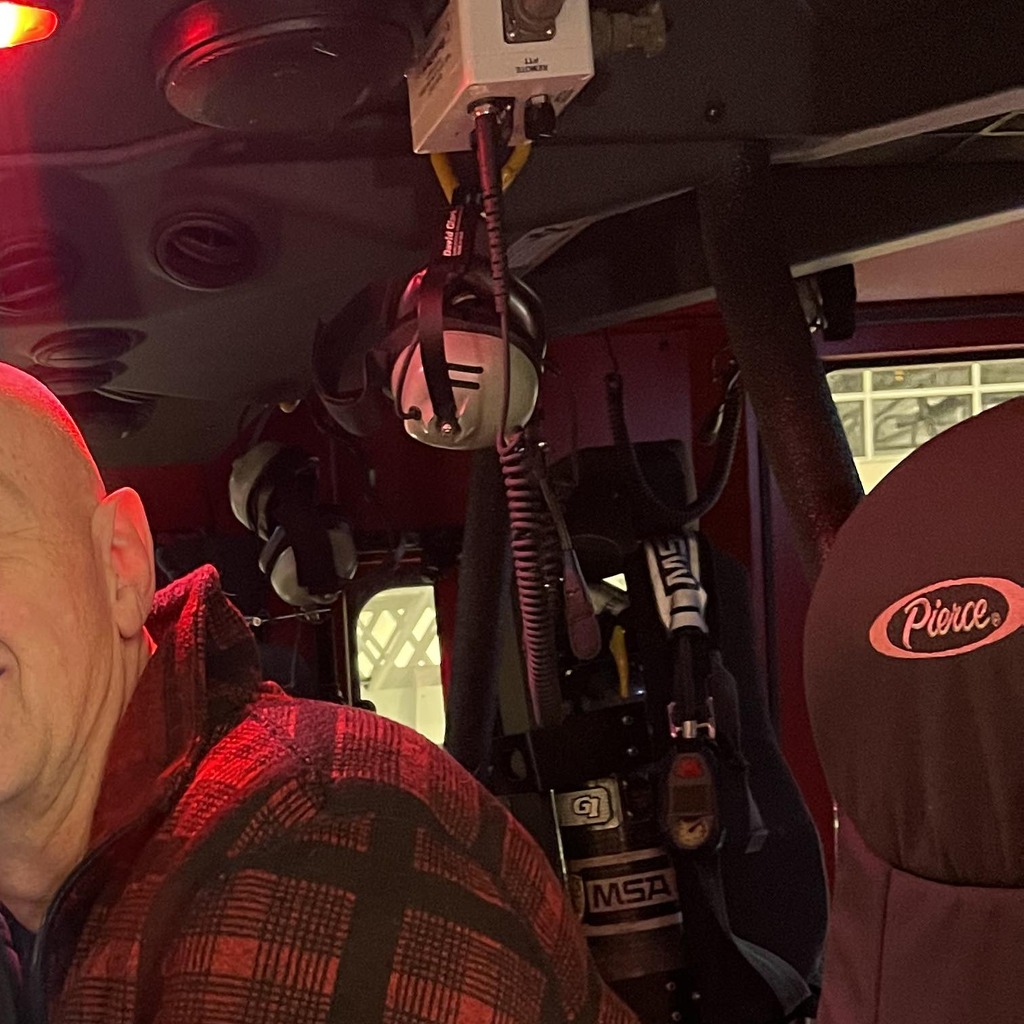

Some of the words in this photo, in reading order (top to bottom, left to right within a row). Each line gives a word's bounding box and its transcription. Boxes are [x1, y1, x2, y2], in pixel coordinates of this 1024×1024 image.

[442, 230, 454, 257] David
[902, 597, 991, 650] Pierce
[592, 874, 671, 909] MSA
